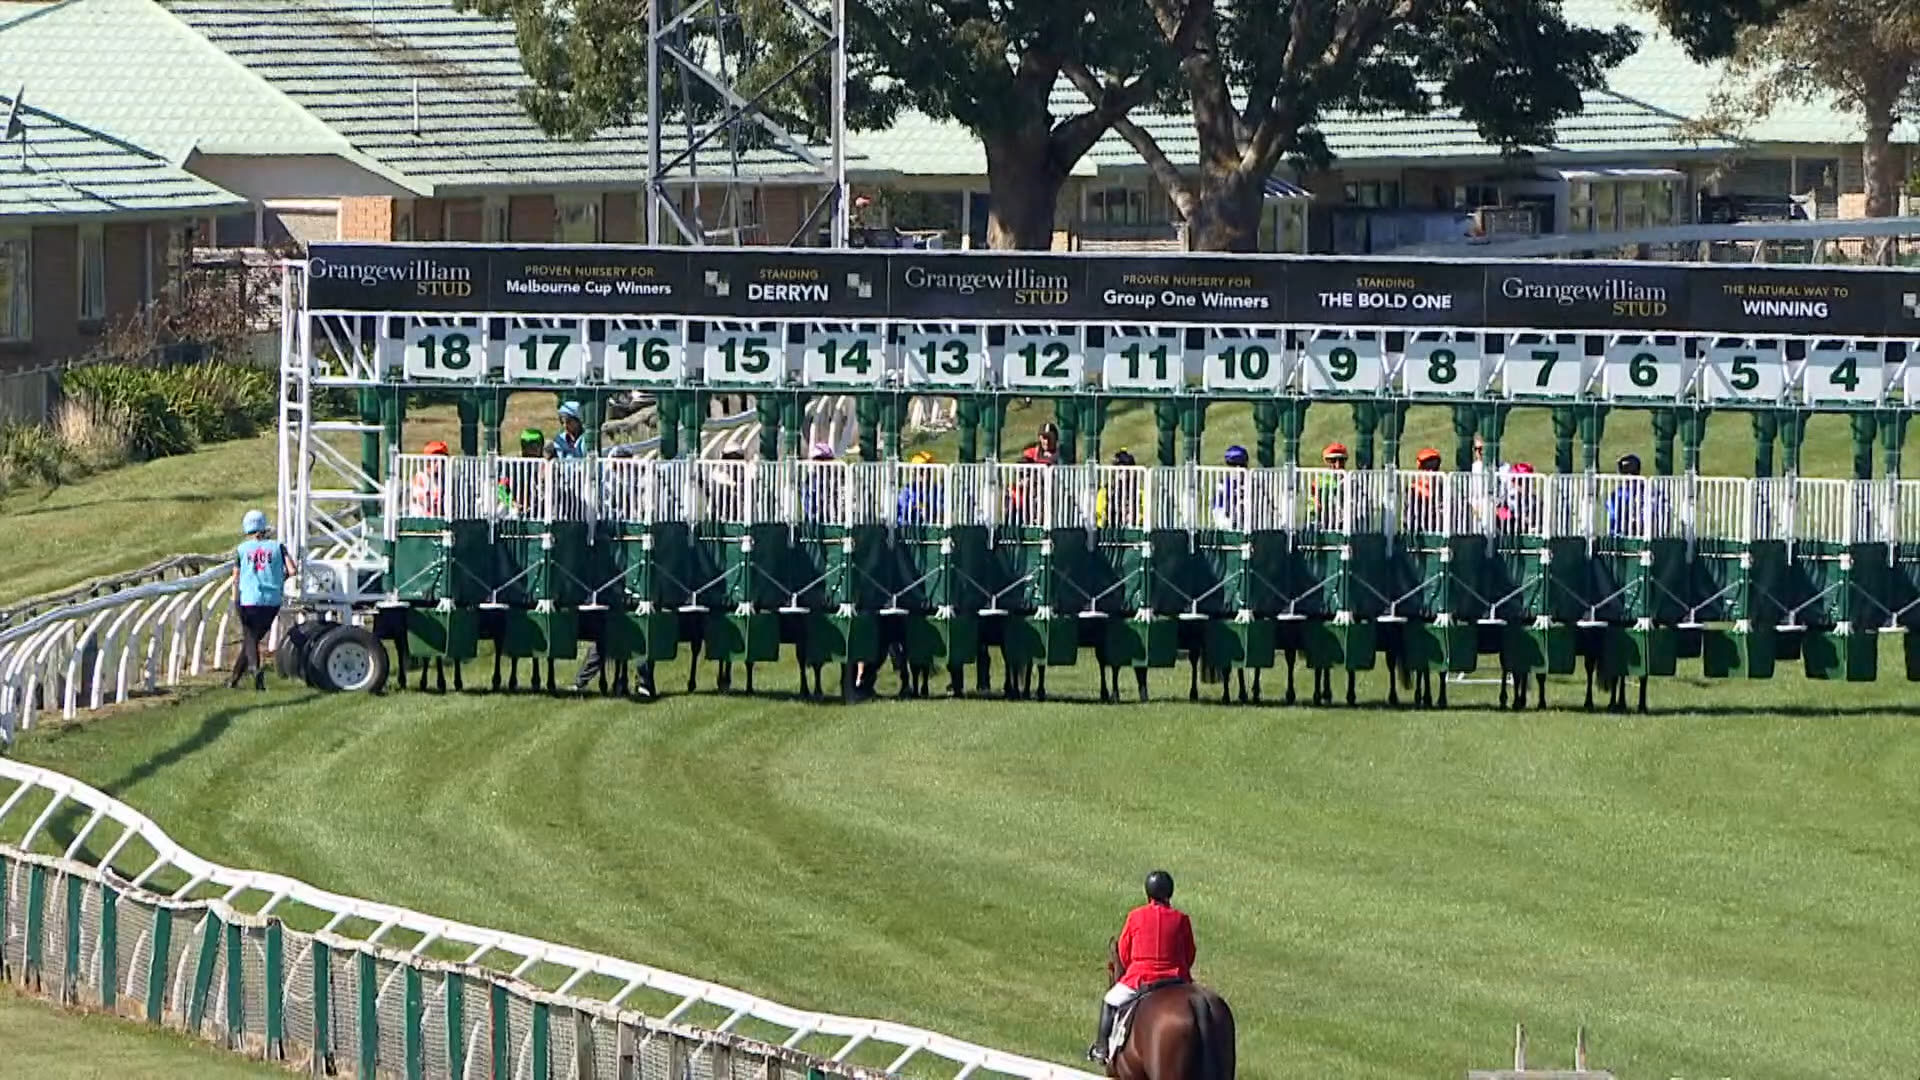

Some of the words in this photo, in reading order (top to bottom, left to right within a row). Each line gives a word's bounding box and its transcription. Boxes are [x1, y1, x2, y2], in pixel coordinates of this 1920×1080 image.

[308, 257, 471, 286] Grangewilliam
[524, 266, 570, 276] PROVEN
[574, 266, 628, 277] NURSERY
[630, 267, 655, 277] FOR
[758, 270, 820, 280] STANDING
[904, 266, 1069, 294] Grangewilliam
[1121, 274, 1169, 284] PROVEN
[1172, 275, 1227, 285] NURSERY
[1229, 276, 1253, 286] FOR
[1355, 277, 1416, 288] STANDING
[416, 281, 472, 297] STUD
[505, 278, 580, 294] Melbourne
[584, 280, 613, 297] Cup
[615, 280, 672, 295] Winners
[747, 283, 829, 302] DERRYN
[1013, 289, 1069, 305] STUD
[1103, 289, 1156, 308] Group
[1160, 291, 1197, 306] One
[1201, 291, 1270, 309] Winners
[1318, 292, 1353, 308] THE
[1357, 292, 1408, 309] BOLD
[1411, 293, 1452, 309] ONE
[1502, 277, 1668, 304] Grangewilliam
[1722, 284, 1744, 294] THE
[1748, 286, 1802, 296] NATURAL
[1804, 287, 1830, 297] WAY
[1832, 287, 1849, 297] TO
[1612, 300, 1667, 317] STUD
[1742, 300, 1828, 318] WINNING
[417, 332, 471, 370] 18
[518, 333, 572, 371] 17
[618, 336, 670, 373] 16
[717, 336, 770, 374] 15
[817, 338, 872, 375] 14
[919, 339, 969, 375] 13
[1017, 341, 1070, 378] 12
[1119, 342, 1168, 380] 11
[1217, 344, 1270, 381] 10
[1328, 346, 1358, 383] 9
[1427, 348, 1457, 385] 8
[1530, 350, 1560, 387] 7
[1629, 352, 1659, 387] 6
[1730, 355, 1760, 391] 5
[1829, 357, 1860, 393] 4
